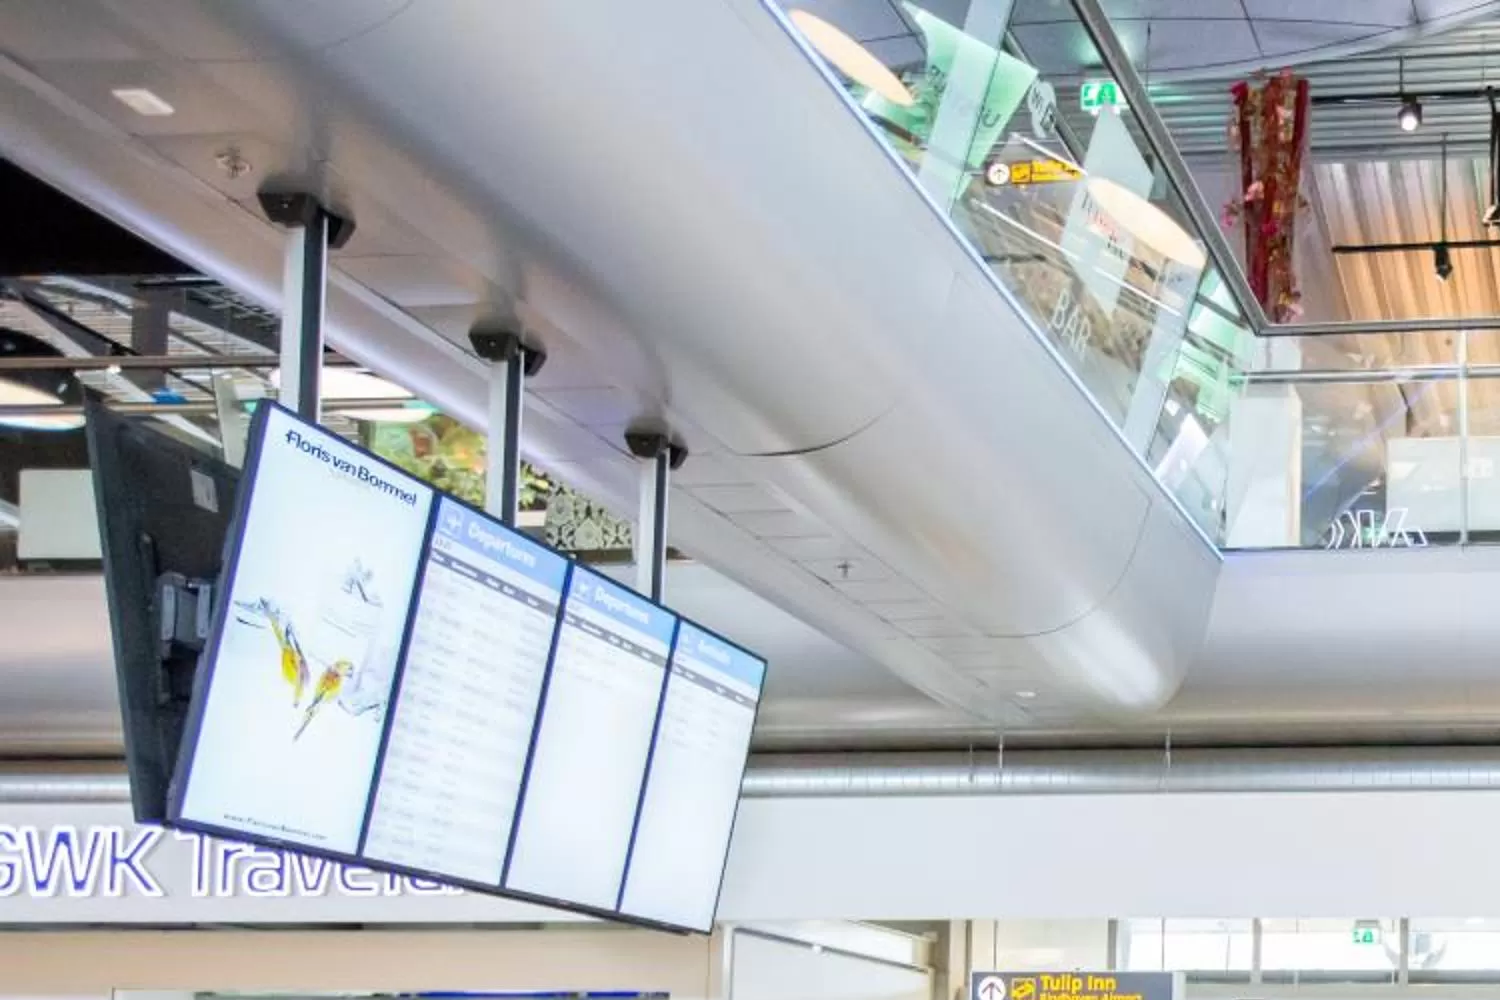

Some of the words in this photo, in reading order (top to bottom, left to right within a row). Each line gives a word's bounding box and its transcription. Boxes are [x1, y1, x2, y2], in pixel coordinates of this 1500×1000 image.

[286, 429, 331, 463] Floris
[1040, 974, 1083, 995] Tulip
[1087, 974, 1117, 992] Inn
